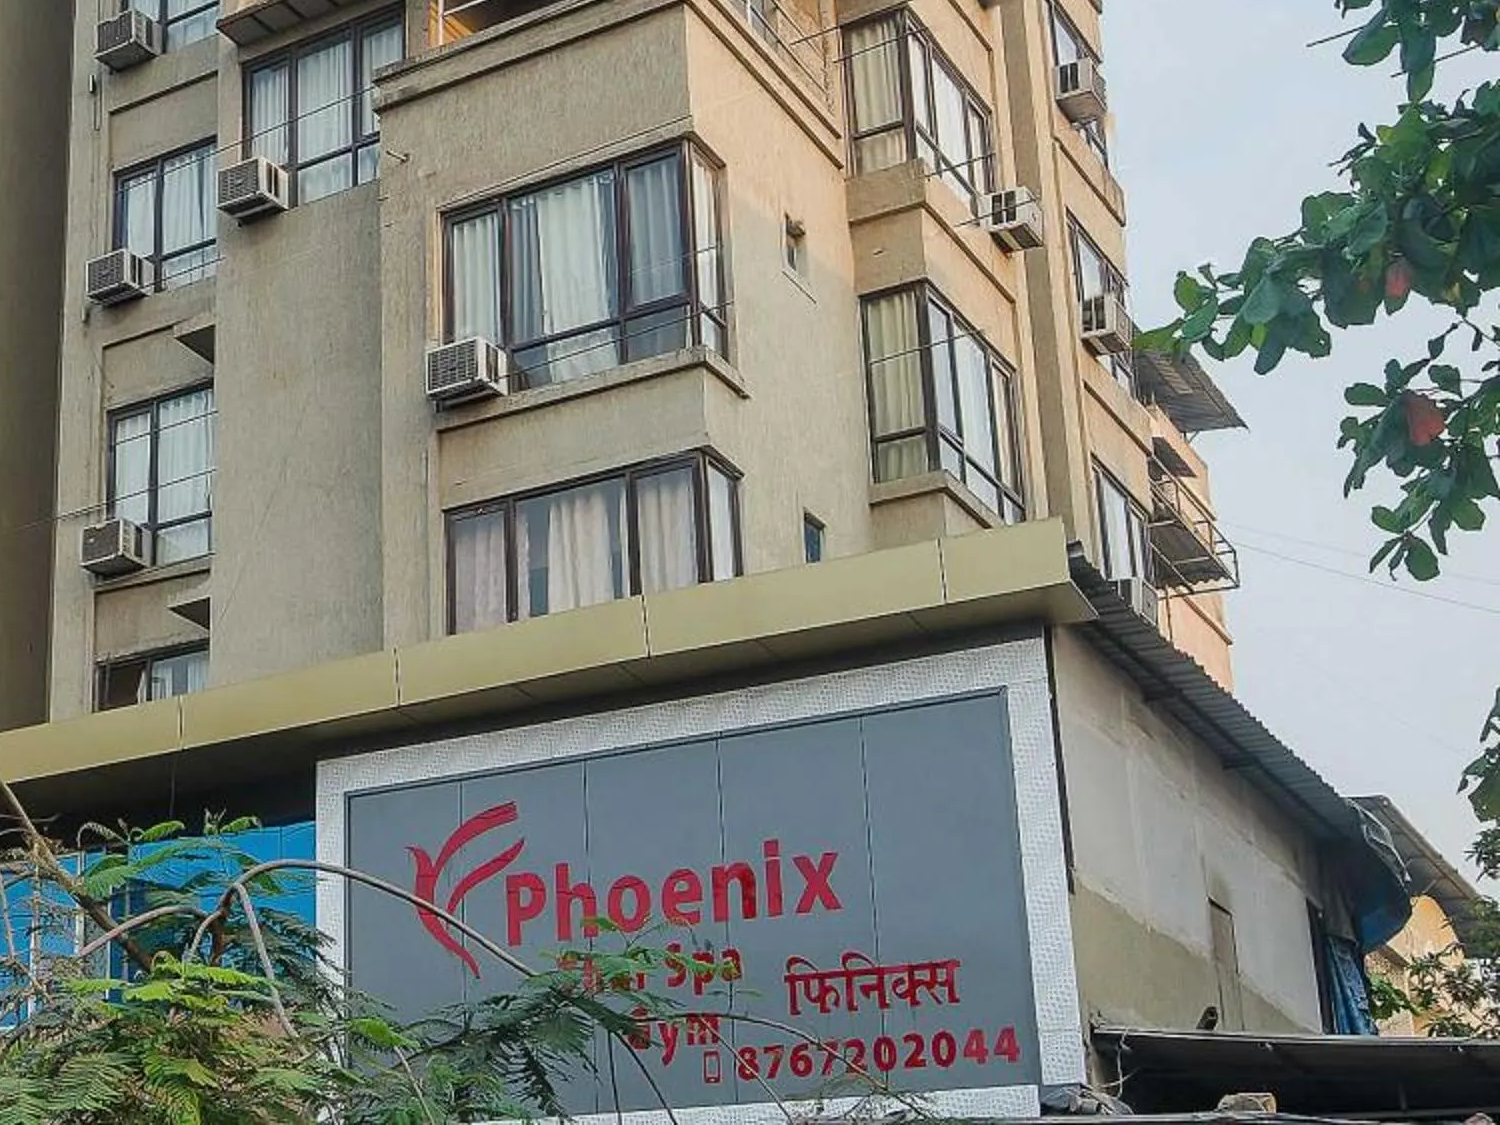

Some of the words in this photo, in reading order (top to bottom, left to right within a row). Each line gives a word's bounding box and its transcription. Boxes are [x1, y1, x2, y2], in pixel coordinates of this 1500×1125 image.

[506, 838, 843, 947] Phoenix
[665, 941, 743, 996] Spa
[784, 951, 961, 1016] फिनिक्स
[736, 1025, 1021, 1083] 8767202044
